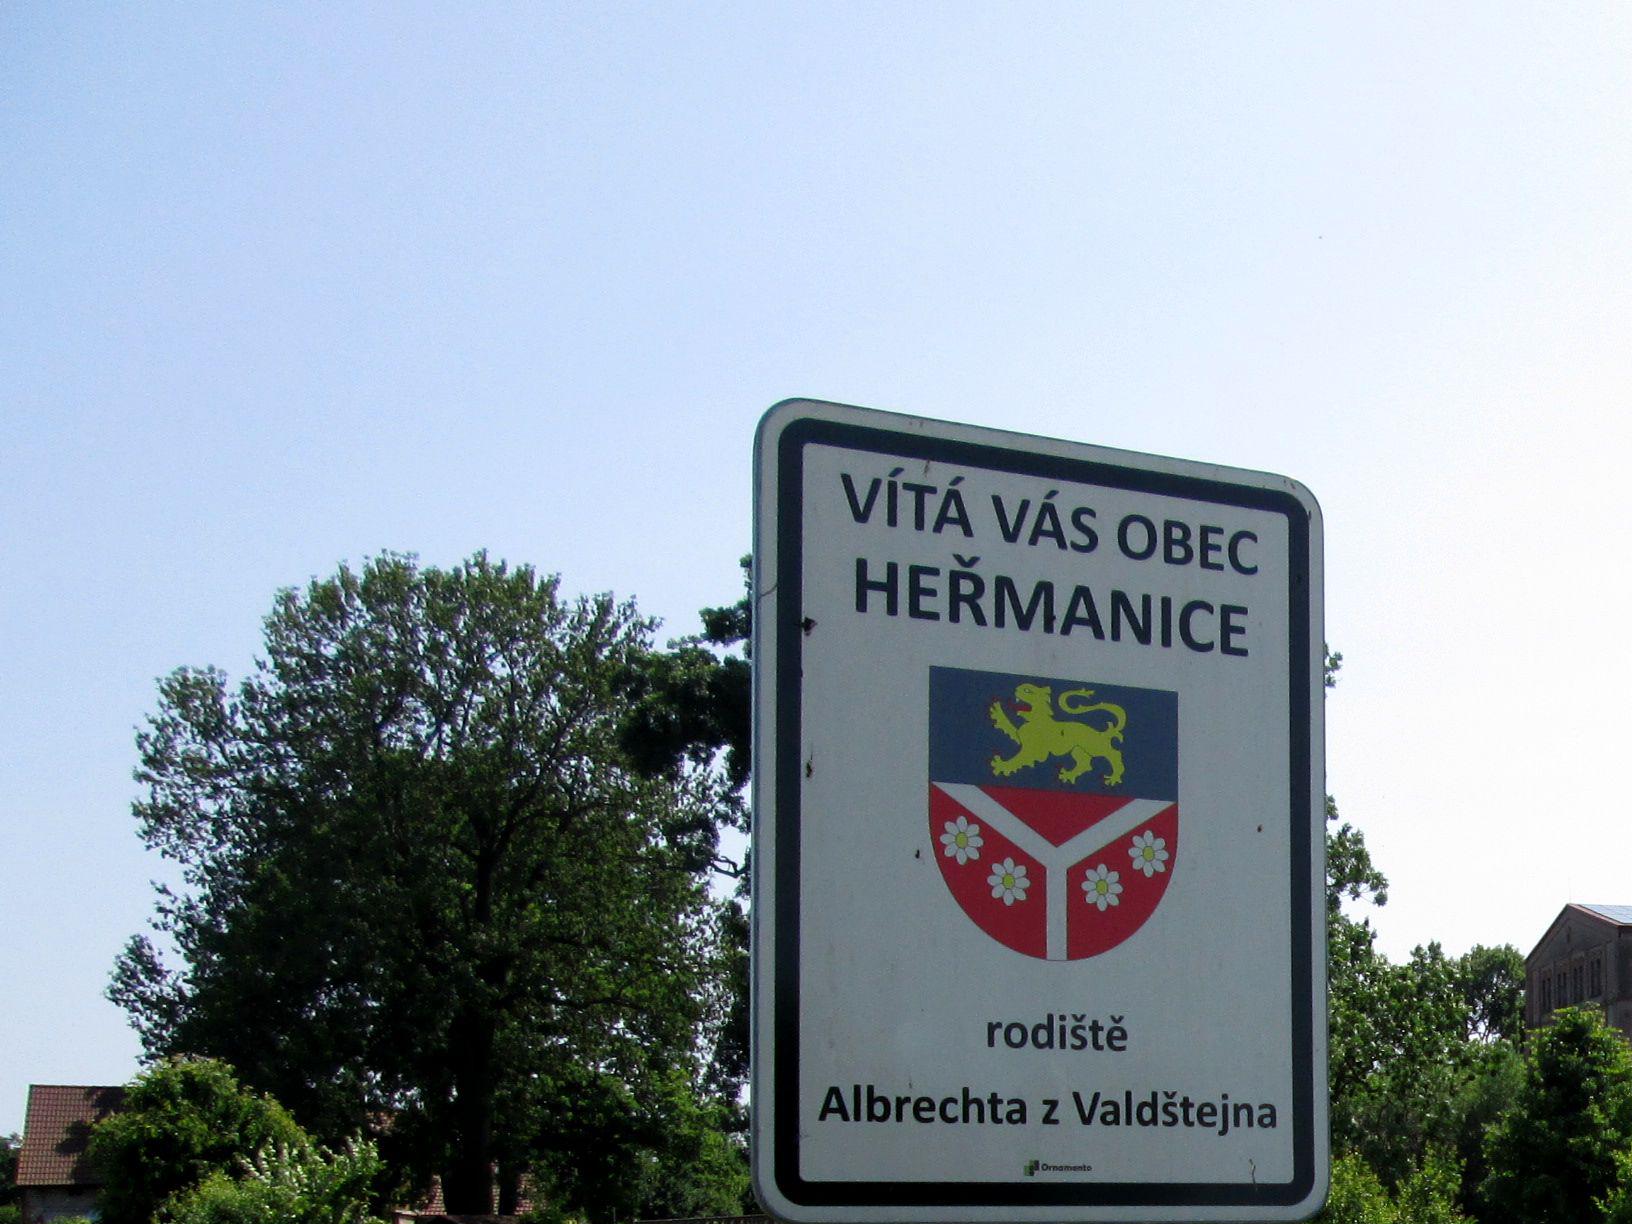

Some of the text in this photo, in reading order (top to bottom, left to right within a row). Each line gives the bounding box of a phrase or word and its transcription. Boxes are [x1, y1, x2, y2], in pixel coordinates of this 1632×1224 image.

[840, 467, 1259, 576] VÍTÁ VÁS OBEC
[855, 553, 1250, 657] HEŘMANICE
[987, 1013, 1128, 1052] rodiště
[819, 1085, 1278, 1137] Albrechta z Valdštejna
[1041, 1162, 1093, 1173] Ornamento
